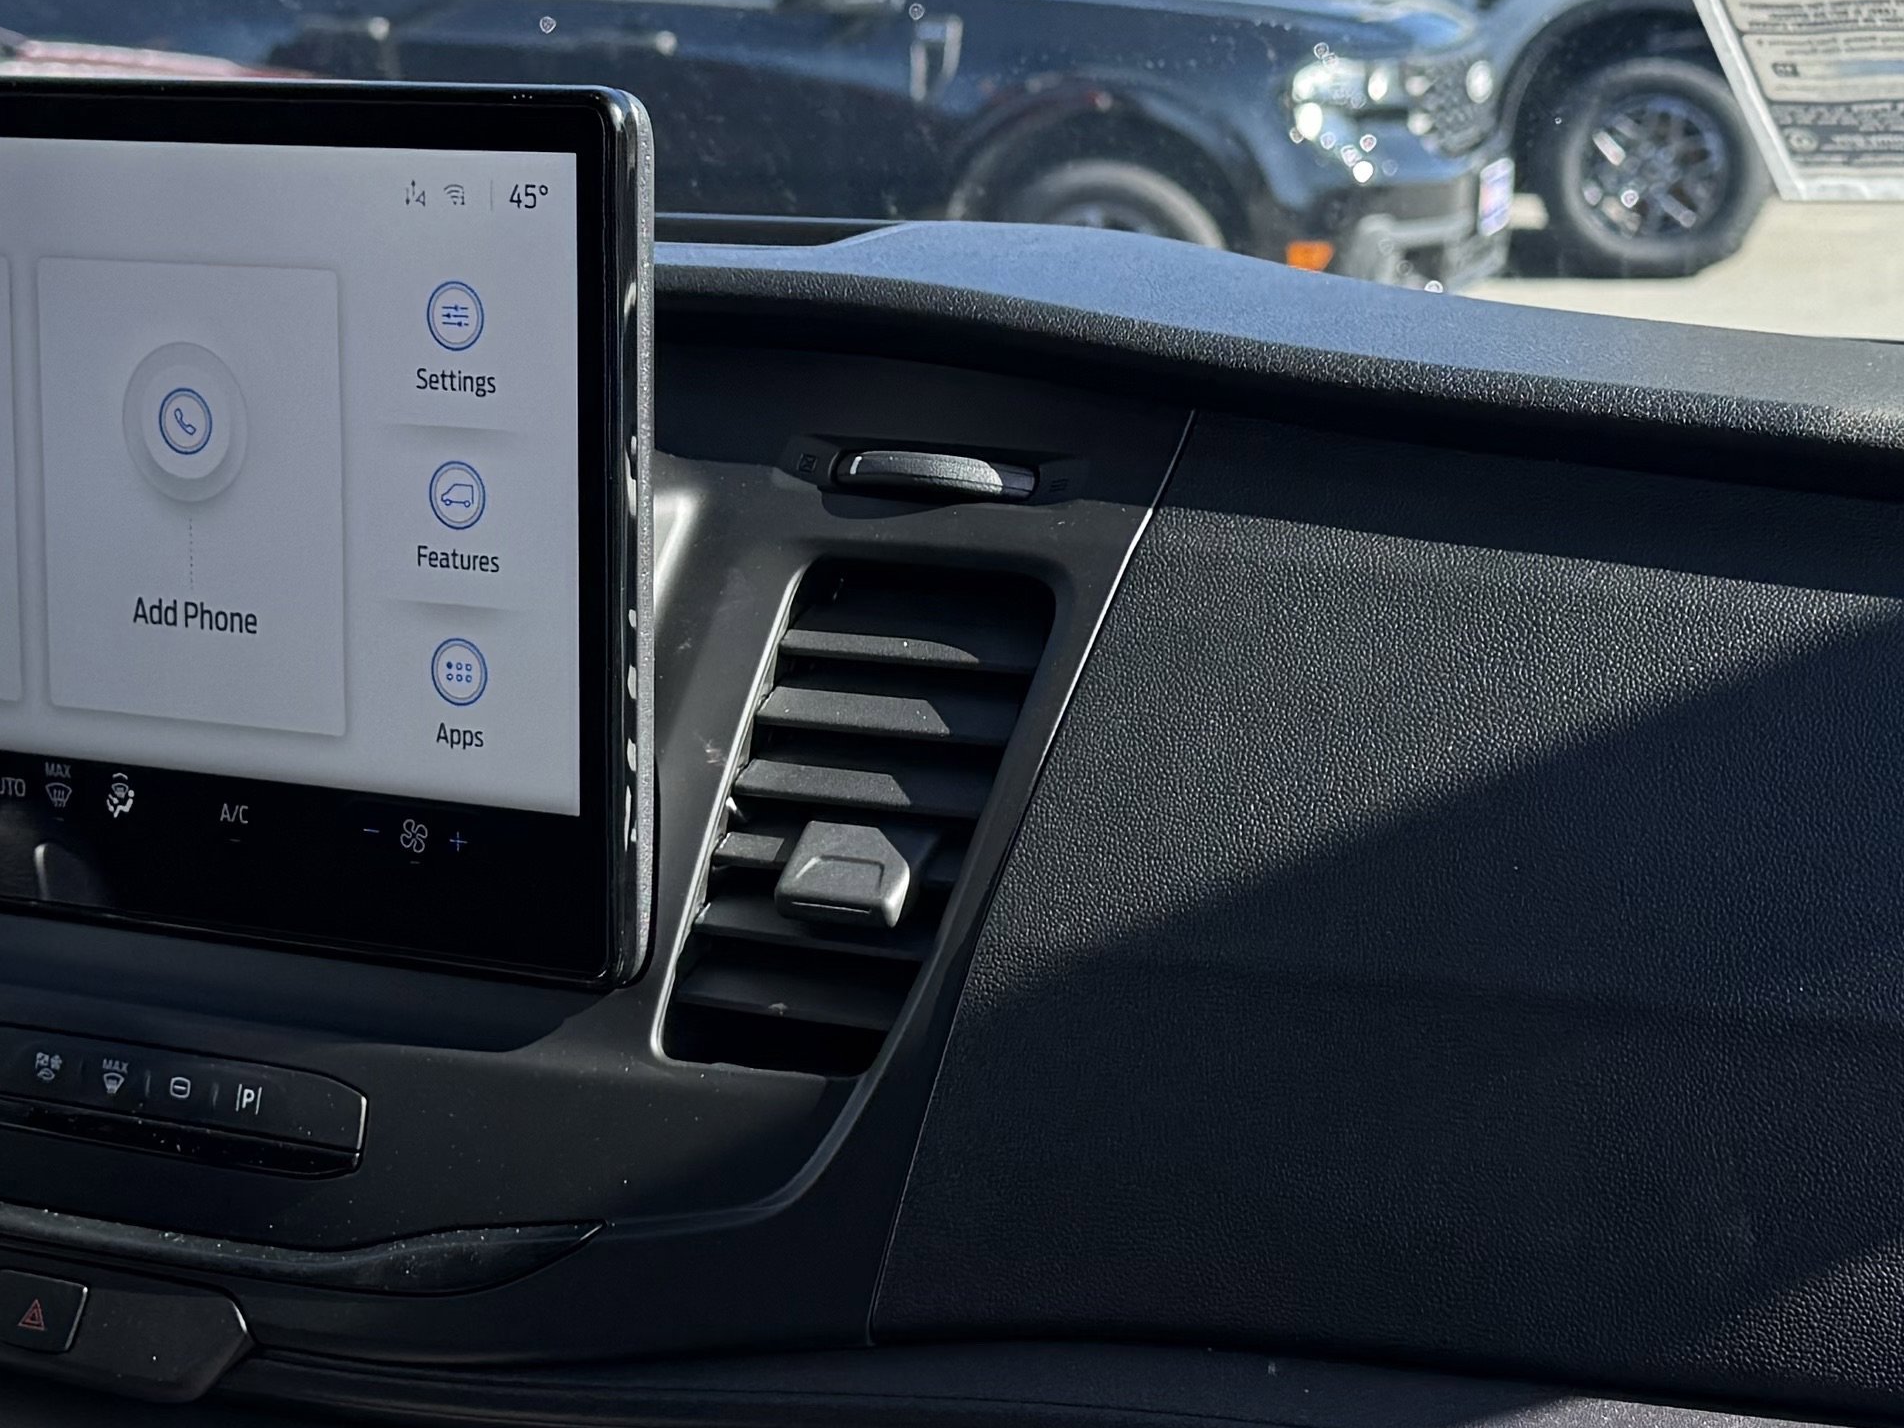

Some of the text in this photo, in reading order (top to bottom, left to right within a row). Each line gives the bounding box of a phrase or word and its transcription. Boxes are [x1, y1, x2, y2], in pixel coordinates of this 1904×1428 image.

[415, 369, 498, 398] Settings
[416, 546, 500, 574] Features
[132, 598, 258, 636] Add Phone
[436, 723, 484, 754] Apps
[45, 762, 72, 780] MAX
[220, 803, 248, 825] A/C
[102, 1058, 128, 1073] MAX
